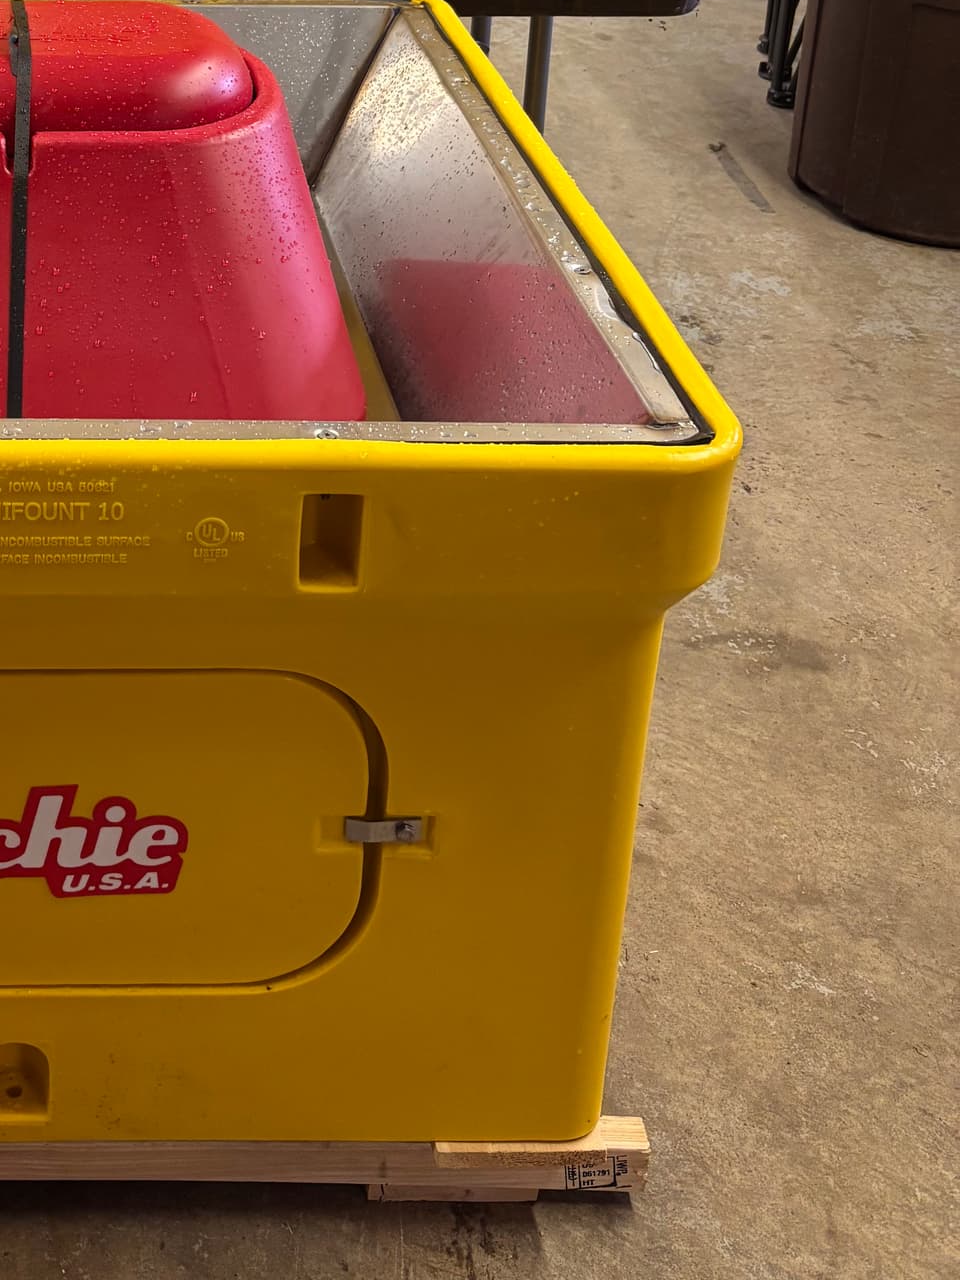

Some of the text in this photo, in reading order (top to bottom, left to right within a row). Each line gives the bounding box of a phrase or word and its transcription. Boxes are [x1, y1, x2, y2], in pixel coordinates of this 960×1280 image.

[8, 479, 41, 493] IOWA
[47, 479, 73, 493] USA
[98, 501, 124, 521] 10
[96, 535, 151, 547] SURFACE
[34, 553, 128, 565] INCOMBUSTIBLE
[193, 548, 228, 558] LISTED
[62, 872, 169, 893] U.S.A.
